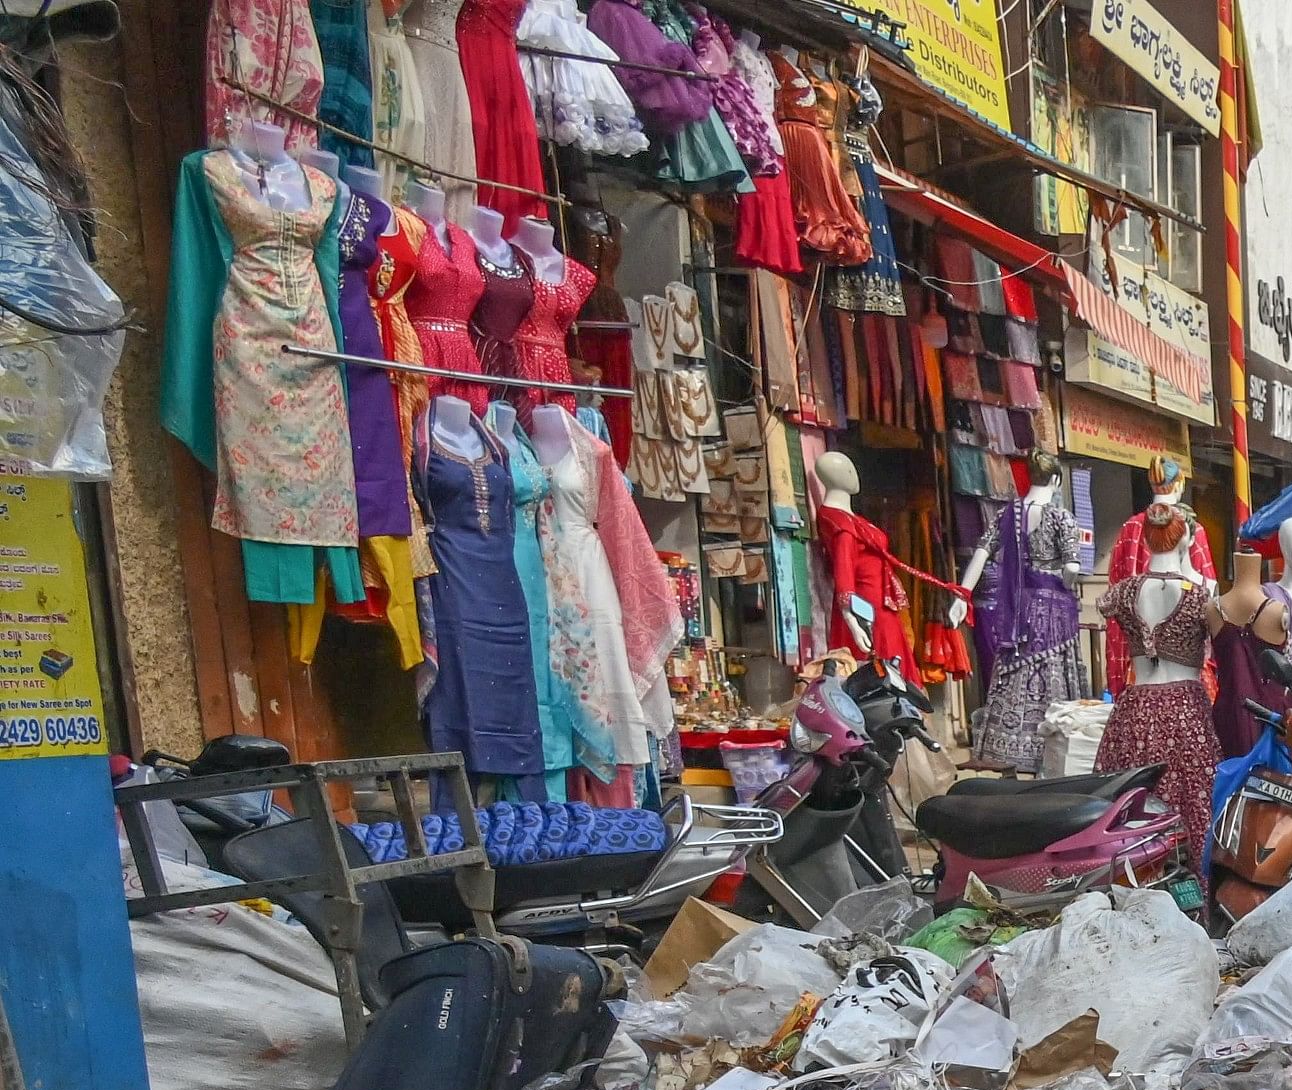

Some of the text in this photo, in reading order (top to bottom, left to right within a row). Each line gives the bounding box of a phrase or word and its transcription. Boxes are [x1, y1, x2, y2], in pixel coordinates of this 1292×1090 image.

[905, 0, 998, 81] ENTERPRISES
[918, 38, 1000, 107] Distributors
[24, 630, 53, 641] Sarees
[3, 648, 22, 661] best
[7, 666, 35, 676] as per
[22, 679, 46, 689] RATE
[7, 698, 93, 710] for New Saree on Spot
[45, 716, 101, 742] 60436
[437, 987, 454, 1031] GOLD FINCH
